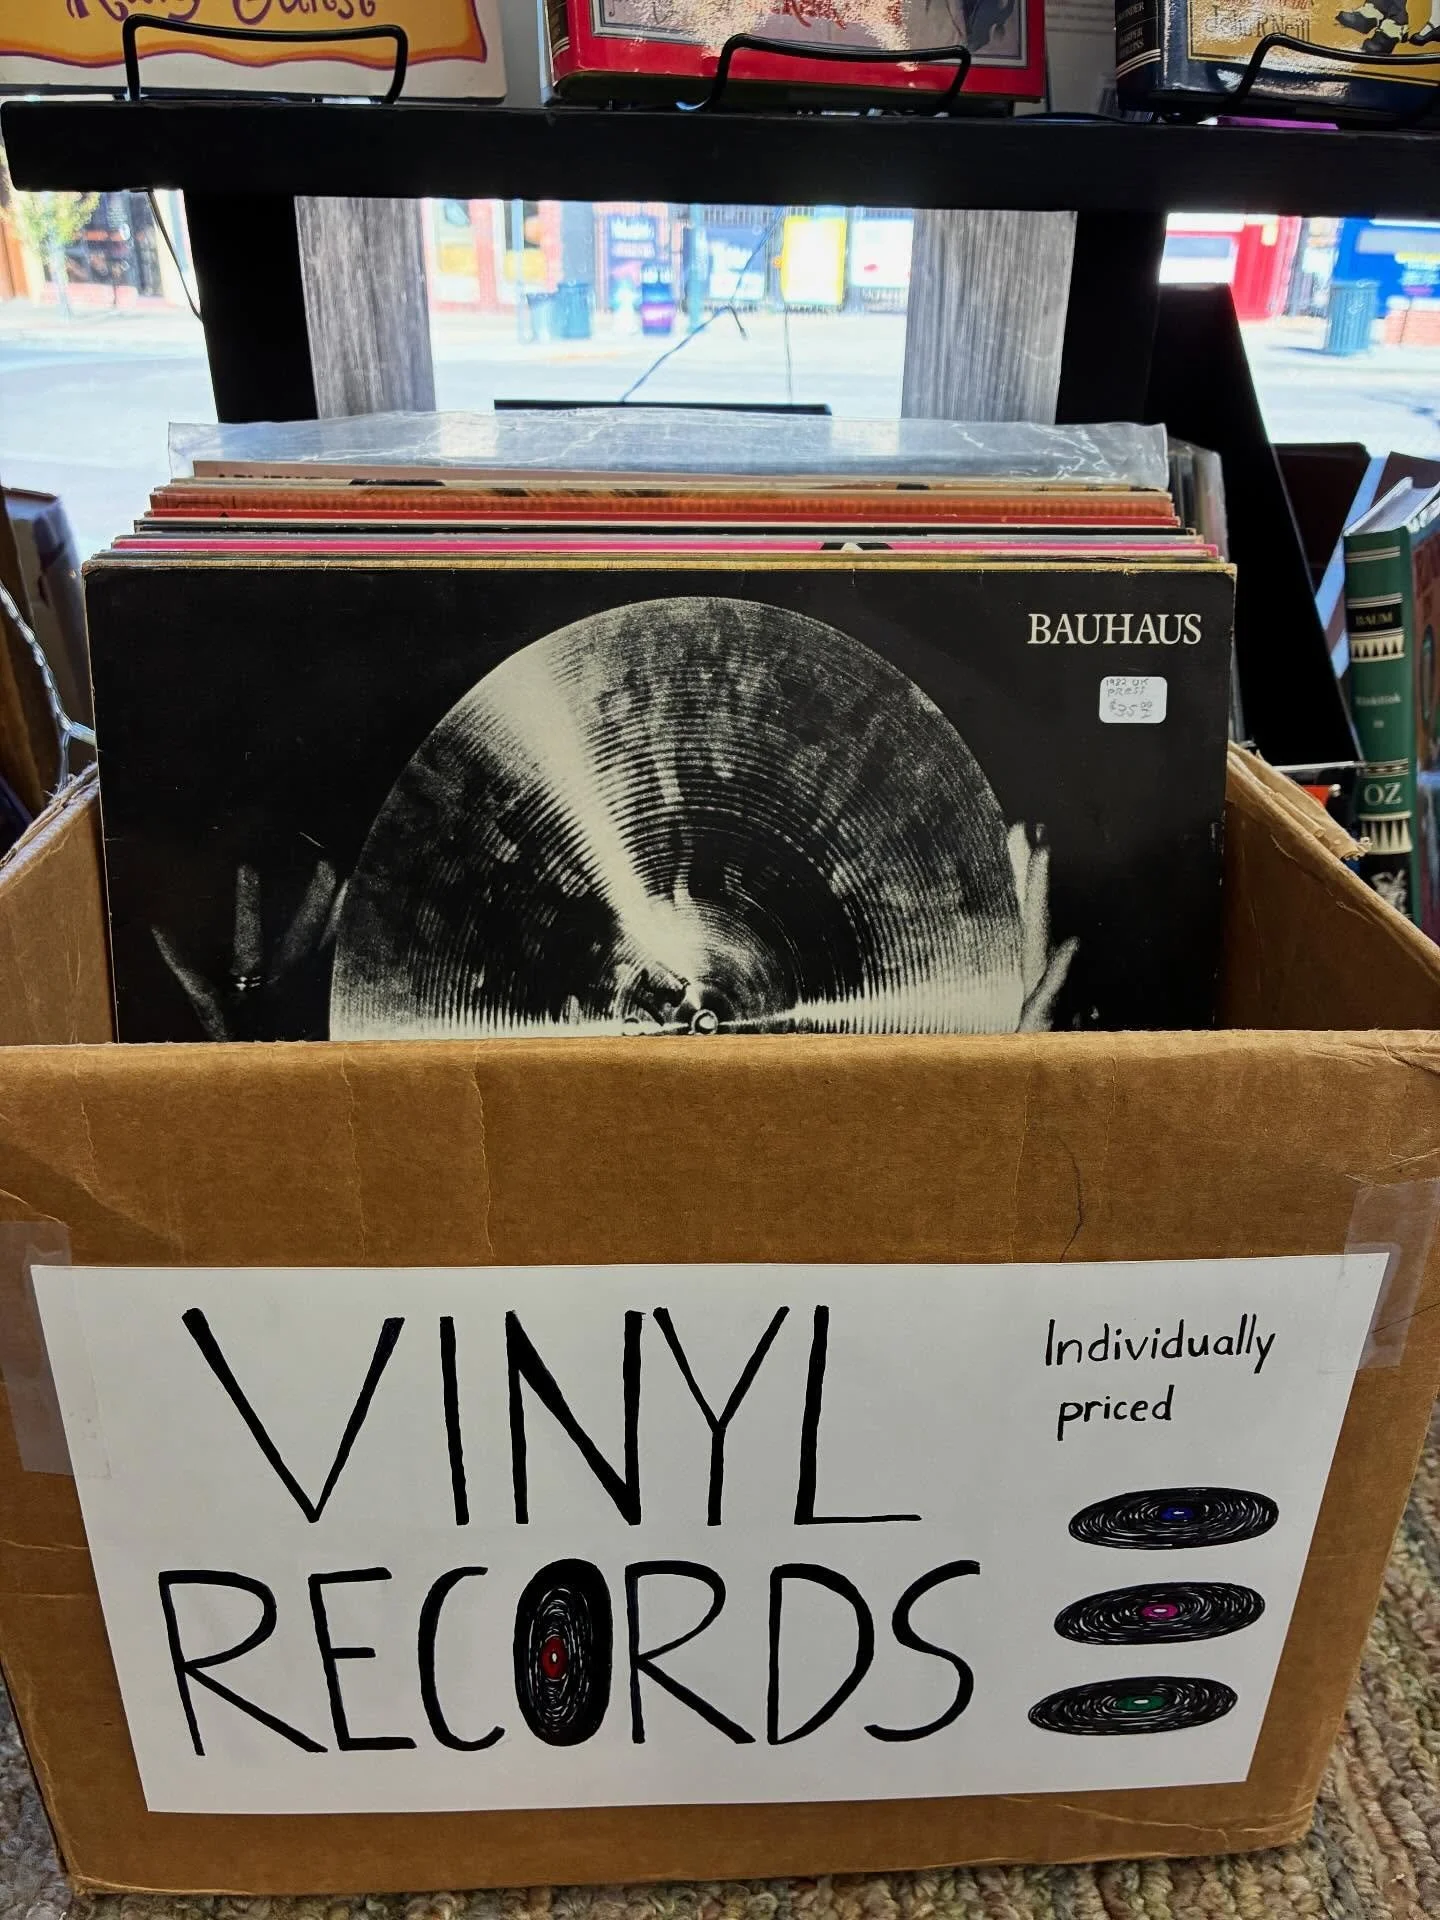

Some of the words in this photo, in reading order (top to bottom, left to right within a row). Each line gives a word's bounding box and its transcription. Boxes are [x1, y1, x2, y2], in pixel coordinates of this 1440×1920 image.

[1027, 613, 1202, 645] BAUHAUS
[1364, 781, 1403, 806] OZ
[1045, 1313, 1276, 1375] Individually
[182, 1305, 922, 1526] VINYL
[1056, 1384, 1175, 1442] priced
[158, 1557, 981, 1757] RECORDS
